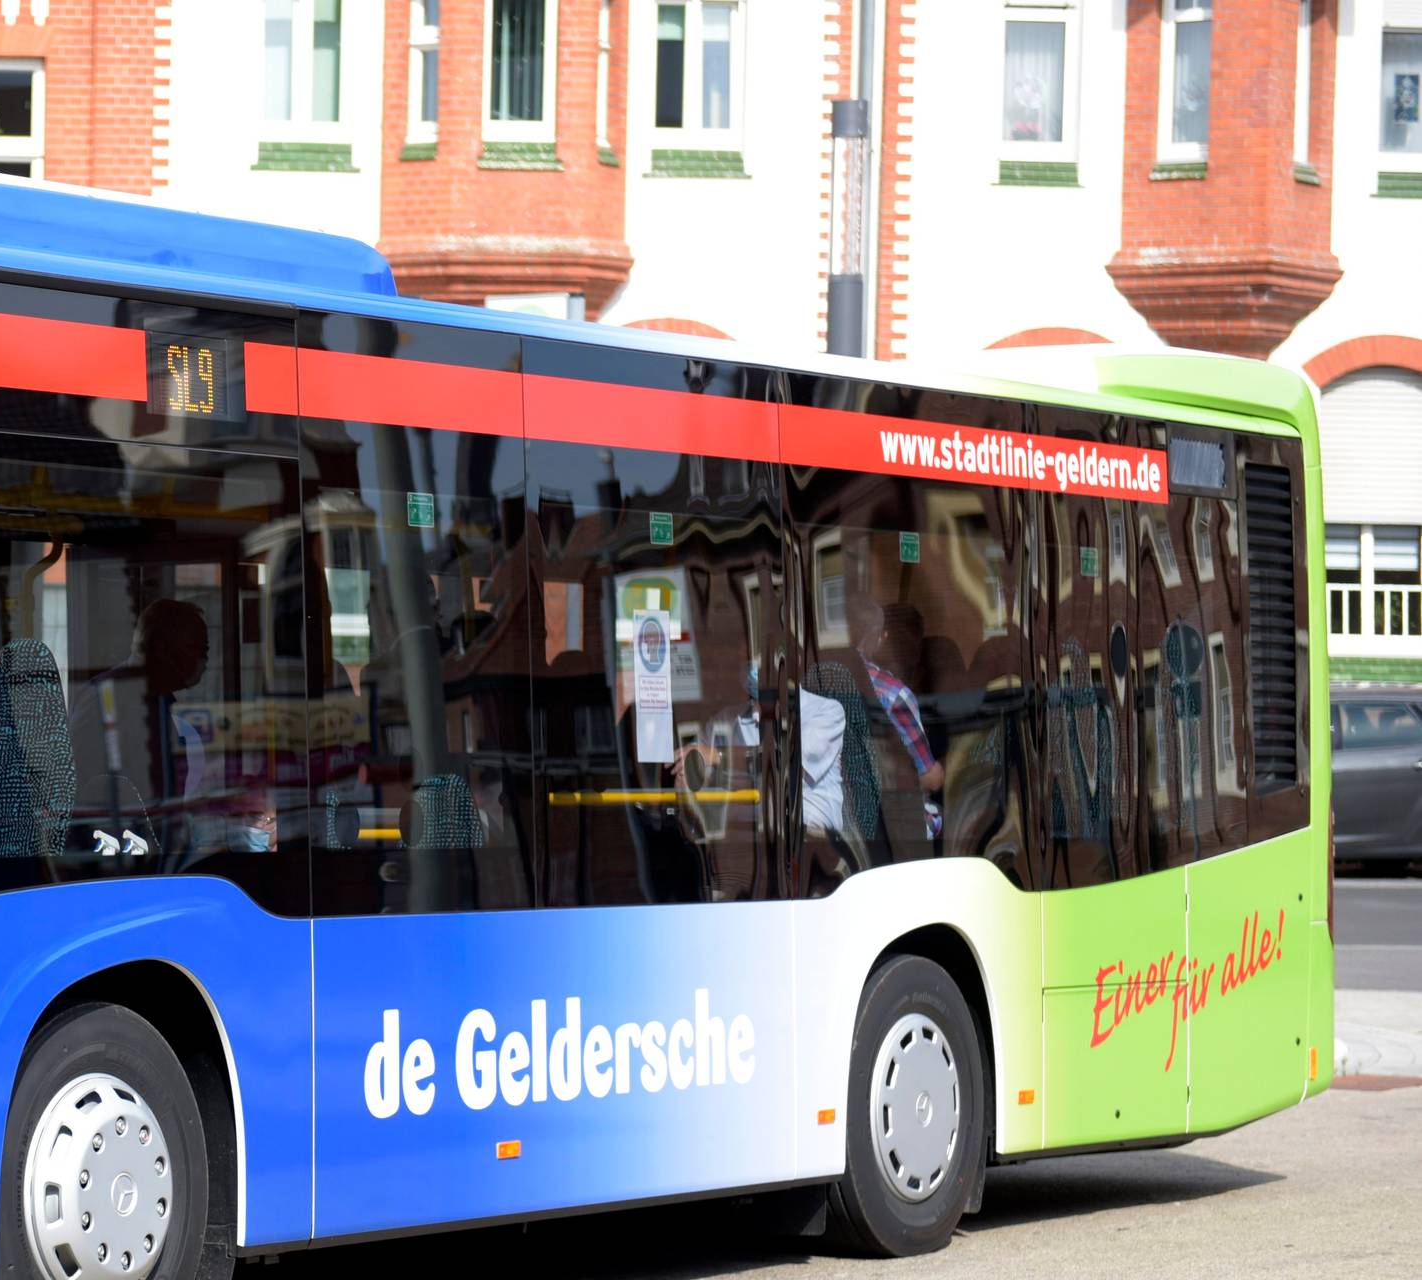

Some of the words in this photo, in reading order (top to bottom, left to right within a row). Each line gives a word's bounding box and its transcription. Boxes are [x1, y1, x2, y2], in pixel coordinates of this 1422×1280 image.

[167, 344, 214, 414] SL9
[879, 430, 1161, 493] www.stadtlinie-geldern.de
[1090, 950, 1173, 1048] Einer
[1165, 955, 1215, 1073] für
[1220, 908, 1285, 997] alle!
[364, 1008, 436, 1119] de
[455, 988, 756, 1111] Geldersche
